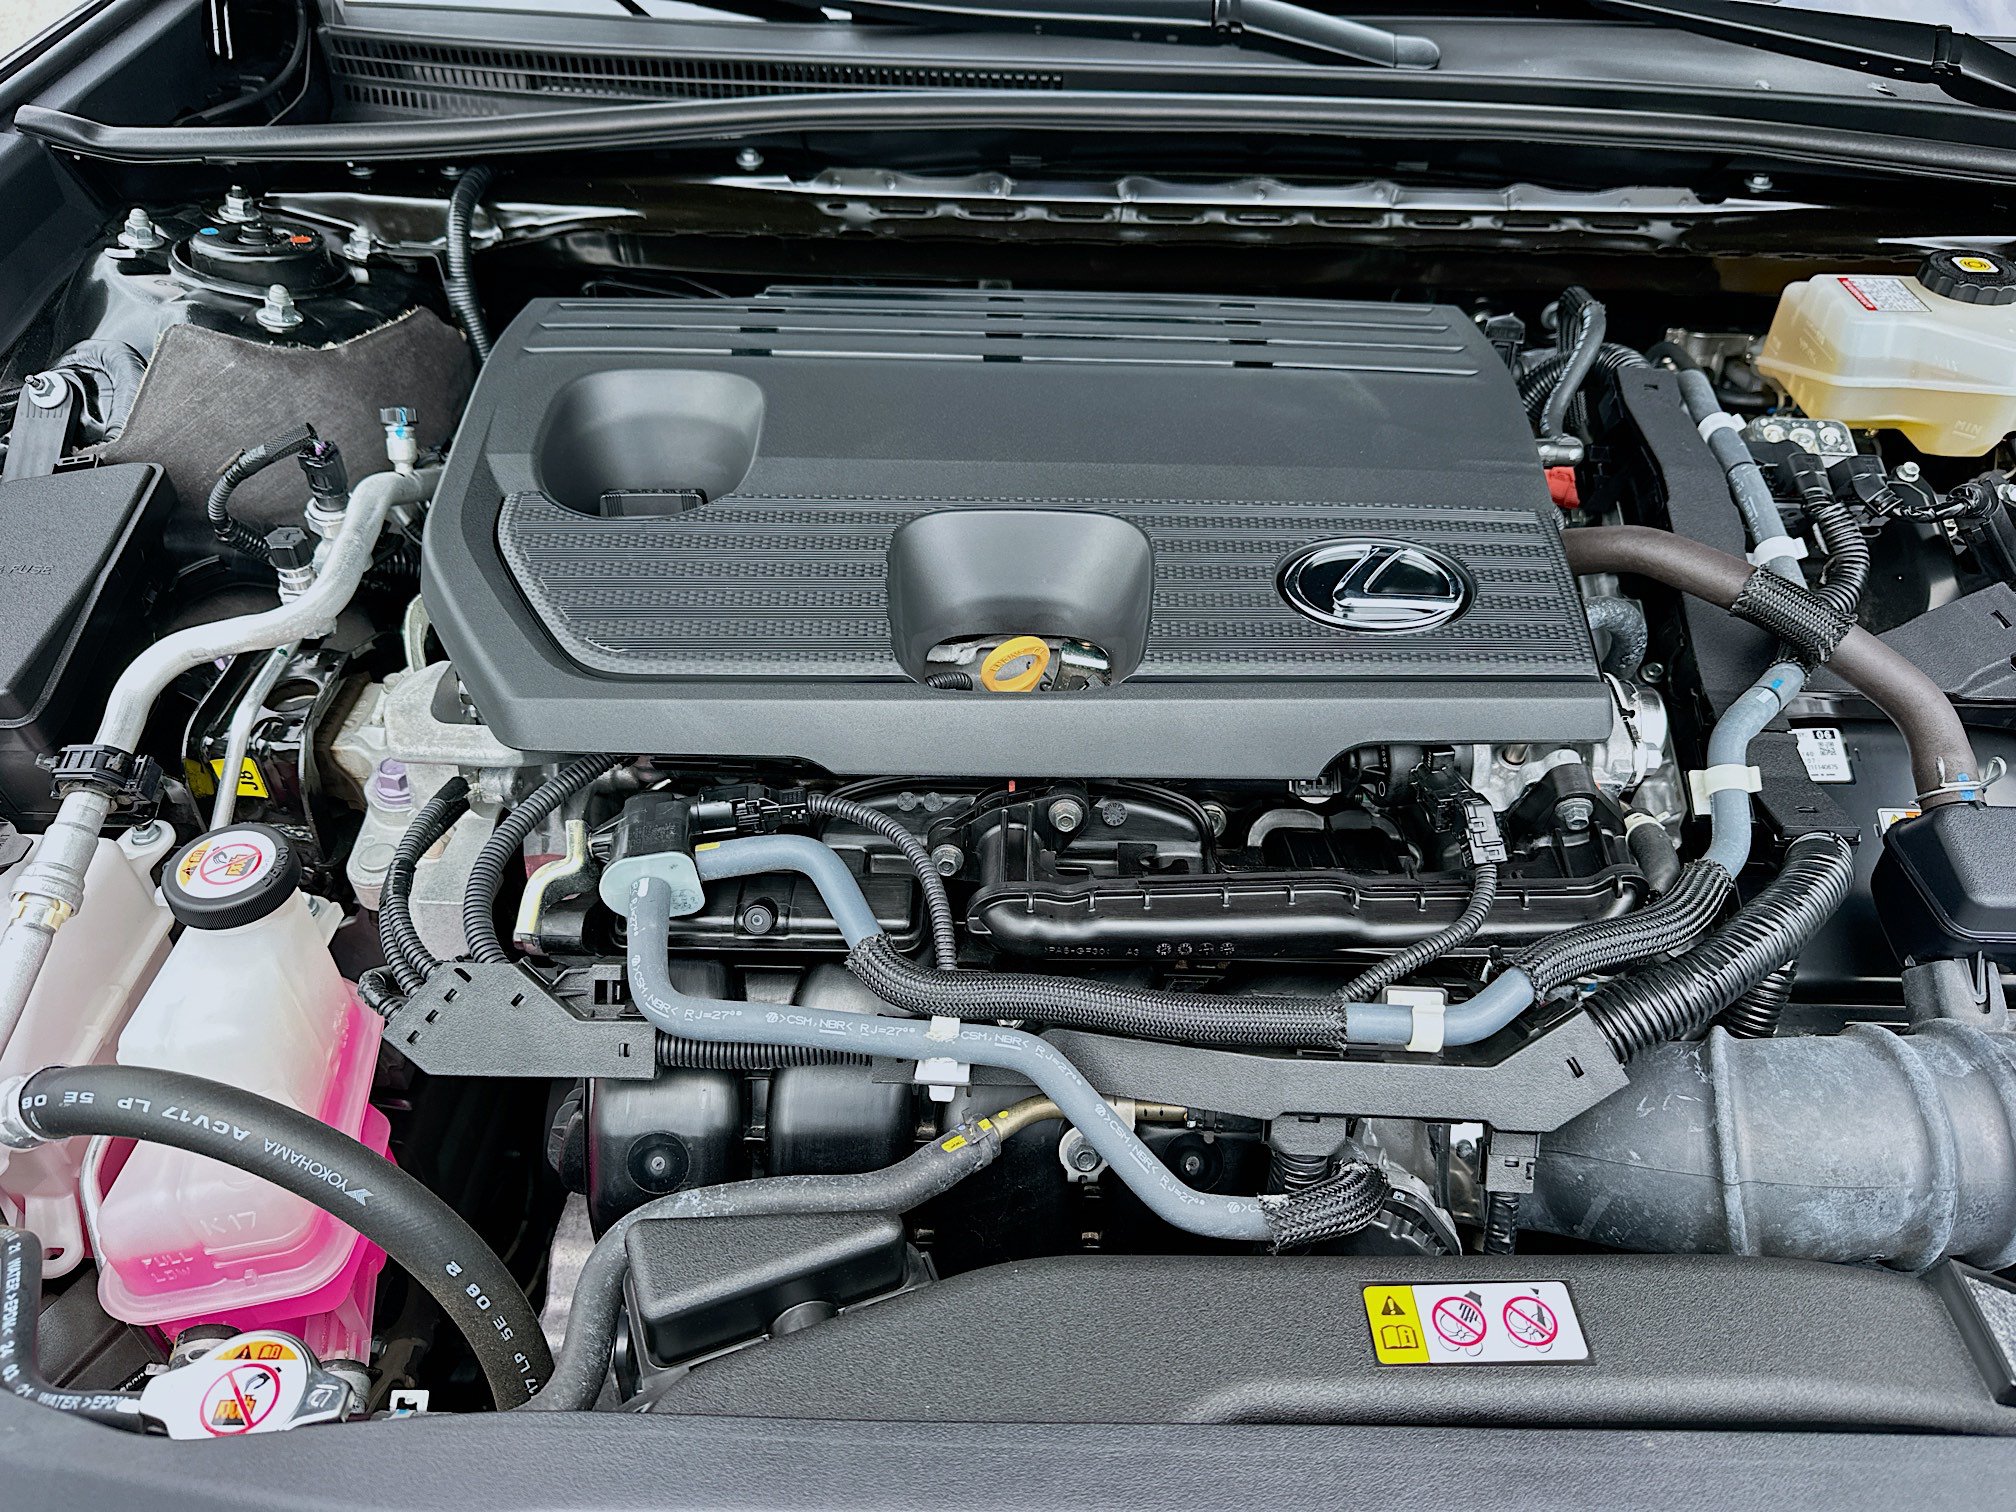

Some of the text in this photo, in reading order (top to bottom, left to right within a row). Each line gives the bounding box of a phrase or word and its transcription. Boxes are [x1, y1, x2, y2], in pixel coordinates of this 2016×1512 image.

[1954, 419, 1983, 434] MIN
[9, 564, 55, 575] FUSE
[1816, 730, 1833, 739] 06
[261, 845, 290, 888] DENSO
[21, 1091, 349, 1193] YOKOHAMA ACV17 LP 5E 08
[445, 1260, 463, 1277] 2
[465, 1283, 492, 1310] 08
[492, 1315, 514, 1341] 5E
[513, 1352, 531, 1374] LP
